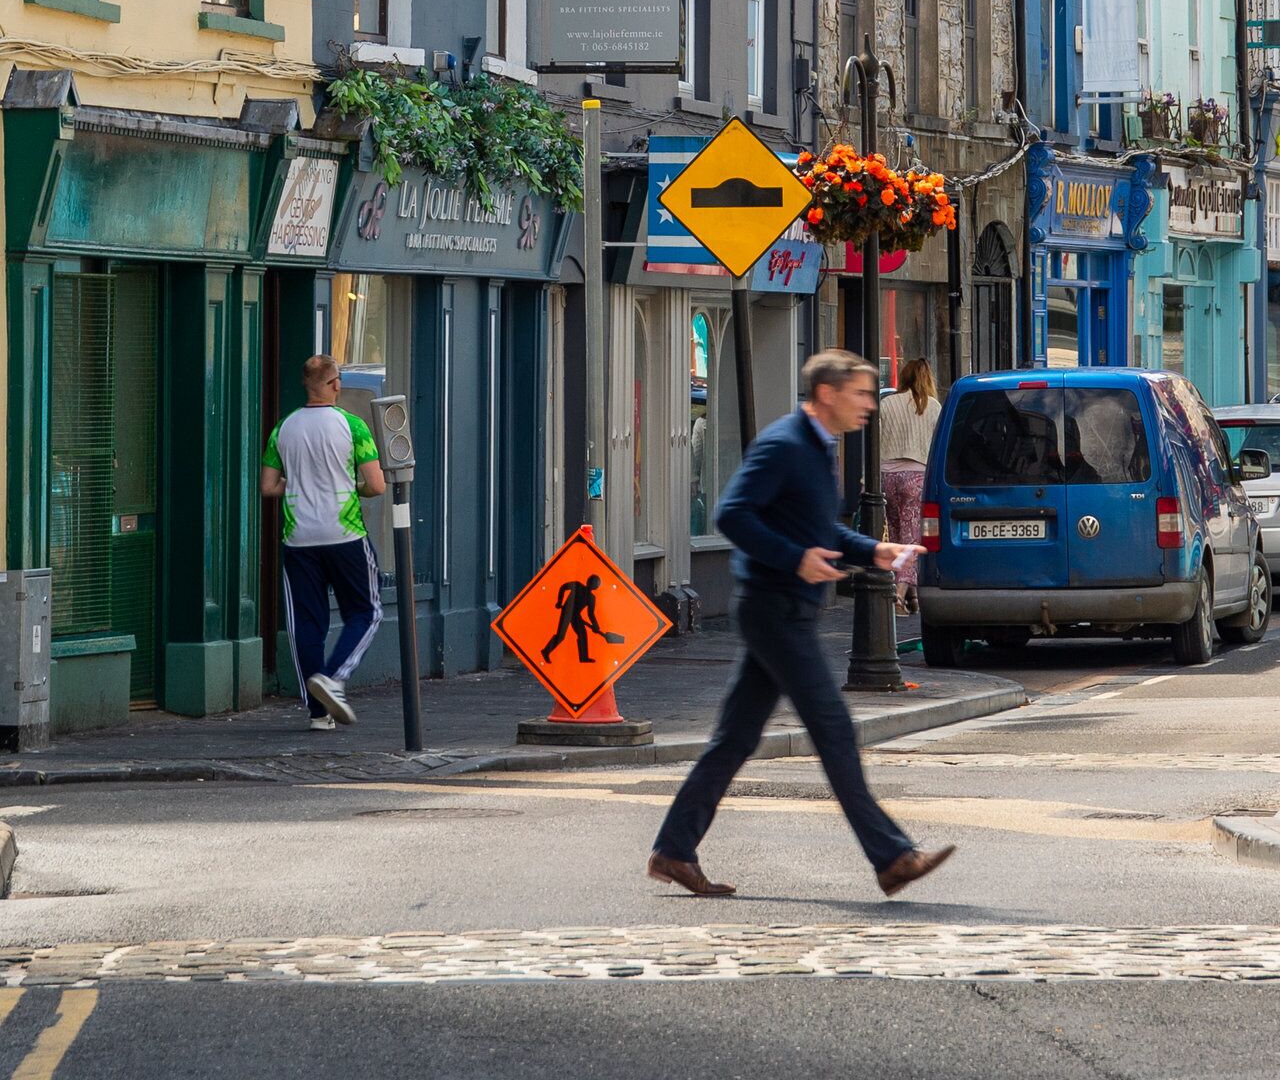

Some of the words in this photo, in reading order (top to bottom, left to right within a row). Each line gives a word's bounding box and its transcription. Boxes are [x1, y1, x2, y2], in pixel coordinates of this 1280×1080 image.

[566, 29, 663, 39] www.lajoliefemme.ie
[580, 43, 590, 51] T:
[592, 42, 650, 51] 065-6845182
[398, 180, 417, 219] LA
[418, 178, 462, 230] JOLIE
[1067, 181, 1112, 219] MOLLOY
[973, 524, 1040, 538] 06-CE-9369
